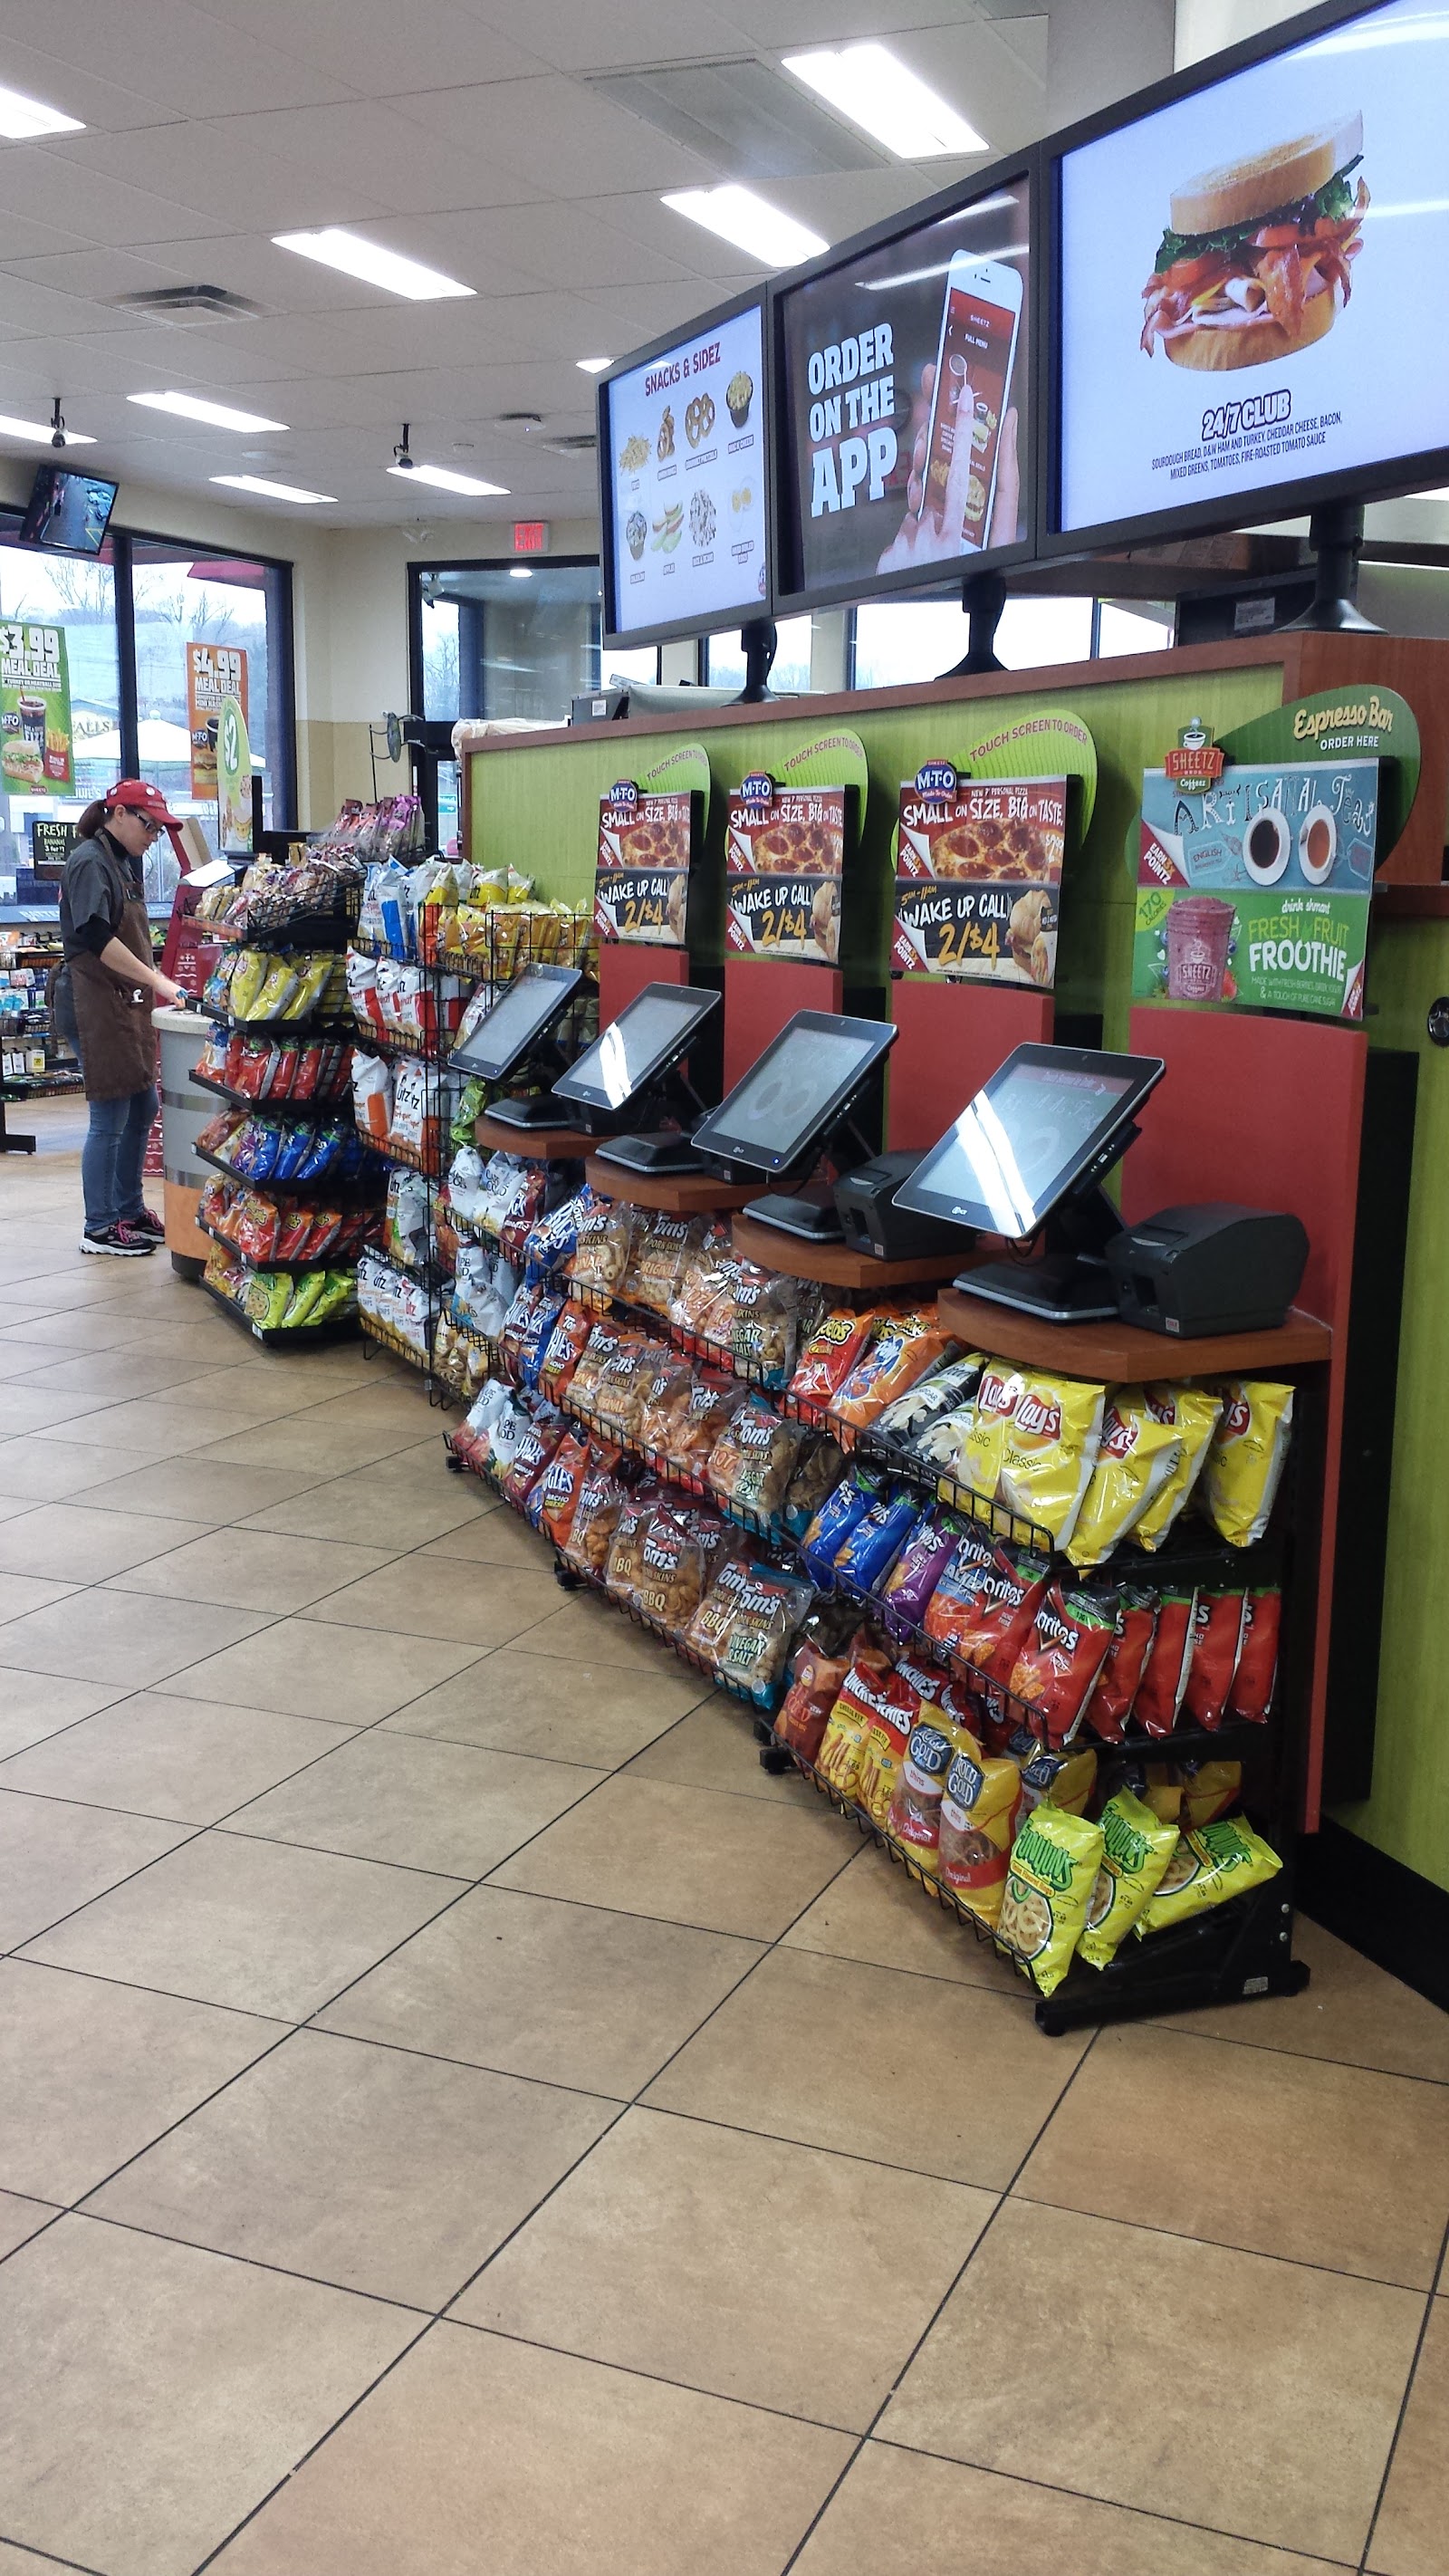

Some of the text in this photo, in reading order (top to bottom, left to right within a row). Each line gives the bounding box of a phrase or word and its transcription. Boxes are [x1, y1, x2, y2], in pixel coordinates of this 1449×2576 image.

[645, 341, 721, 397] SNACKS & SIDEZ
[808, 322, 894, 395] ORDER
[809, 378, 894, 443] ON THE
[1202, 389, 1291, 442] 24/7 CLUB
[1151, 452, 1184, 470] SOURDOUGH
[1184, 447, 1203, 462] BREAD,
[1217, 439, 1230, 454] HAM
[1231, 437, 1243, 449] AND
[1267, 423, 1294, 441] CHEDDAR
[1295, 417, 1319, 434] CHEESE,
[1319, 410, 1343, 428] BACON,
[1170, 466, 1186, 480] MIXED
[1187, 460, 1209, 476] GREENS,
[1211, 452, 1241, 470] TOMATOES,
[1281, 436, 1306, 453] TOMATO
[1306, 431, 1326, 447] SAUCE
[811, 427, 897, 518] APP
[514, 523, 544, 552] EXIT
[0, 624, 61, 663] $3.99
[1, 658, 61, 678] MEAL DEAL
[193, 647, 241, 681] $4.99
[196, 677, 241, 696] MEAL DEAL
[73, 718, 110, 733] ALLS
[1294, 696, 1393, 741] Espresso Bar
[784, 746, 813, 772] TOUCH
[814, 737, 840, 754] SCREEN
[970, 719, 1087, 762] TOUCH SCREEN TO ORDER
[1319, 735, 1379, 750] ORDER HERE
[647, 751, 693, 781] TOUCH SCREEN
[1172, 751, 1214, 770] SHEETZ
[971, 786, 1028, 798] NEW PERSONAL PIZZA
[1180, 778, 1206, 791] Coffeez
[602, 812, 635, 829] SMALL
[730, 808, 770, 829] SMALL
[770, 810, 780, 822] ON
[809, 803, 823, 823] BIG
[903, 803, 954, 826] SMALL
[955, 804, 967, 818] ON
[1008, 795, 1028, 821] BIG
[37, 822, 67, 839] FRESH
[900, 848, 919, 878] POINTZ
[1149, 842, 1167, 865] EARN
[1193, 848, 1223, 862] ENGLISH
[1144, 852, 1172, 885] POINTZ
[600, 878, 667, 904] WAKE UP CALL
[734, 884, 811, 914] WAKE UP CALL
[1138, 891, 1162, 918] 170
[624, 898, 664, 936] 2/$4
[903, 893, 1007, 928] WAKE UP CALL
[1281, 898, 1304, 914] drink
[762, 908, 808, 950] 2/$4
[1249, 915, 1350, 947] FRESH FRUIT
[894, 941, 916, 970] POINTZ
[938, 920, 1001, 971] 2/$4
[1182, 964, 1212, 980] SHEETZ
[1250, 939, 1348, 982] FROOTHIE
[1260, 985, 1266, 999] &
[1014, 1393, 1061, 1436] Lay's
[740, 1419, 774, 1446] Tom's
[710, 1450, 740, 1470] HOT
[1003, 1447, 1041, 1472] Classic
[546, 1494, 570, 1504] NACHO
[643, 1537, 678, 1571] Tom's
[653, 1572, 677, 1583] SKINS
[642, 1590, 667, 1611] BBQ
[739, 1586, 782, 1615] Tom's
[700, 1610, 726, 1632] BBQ
[729, 1635, 766, 1656] VINEGAR
[896, 1665, 941, 1701] UNCHIES
[909, 1736, 942, 1771] GOLD
[909, 1770, 925, 1787] thins
[955, 1758, 977, 1783] ROLD
[947, 1775, 974, 1807] GOLD
[903, 1822, 933, 1842] Original
[945, 1869, 972, 1885] Original
